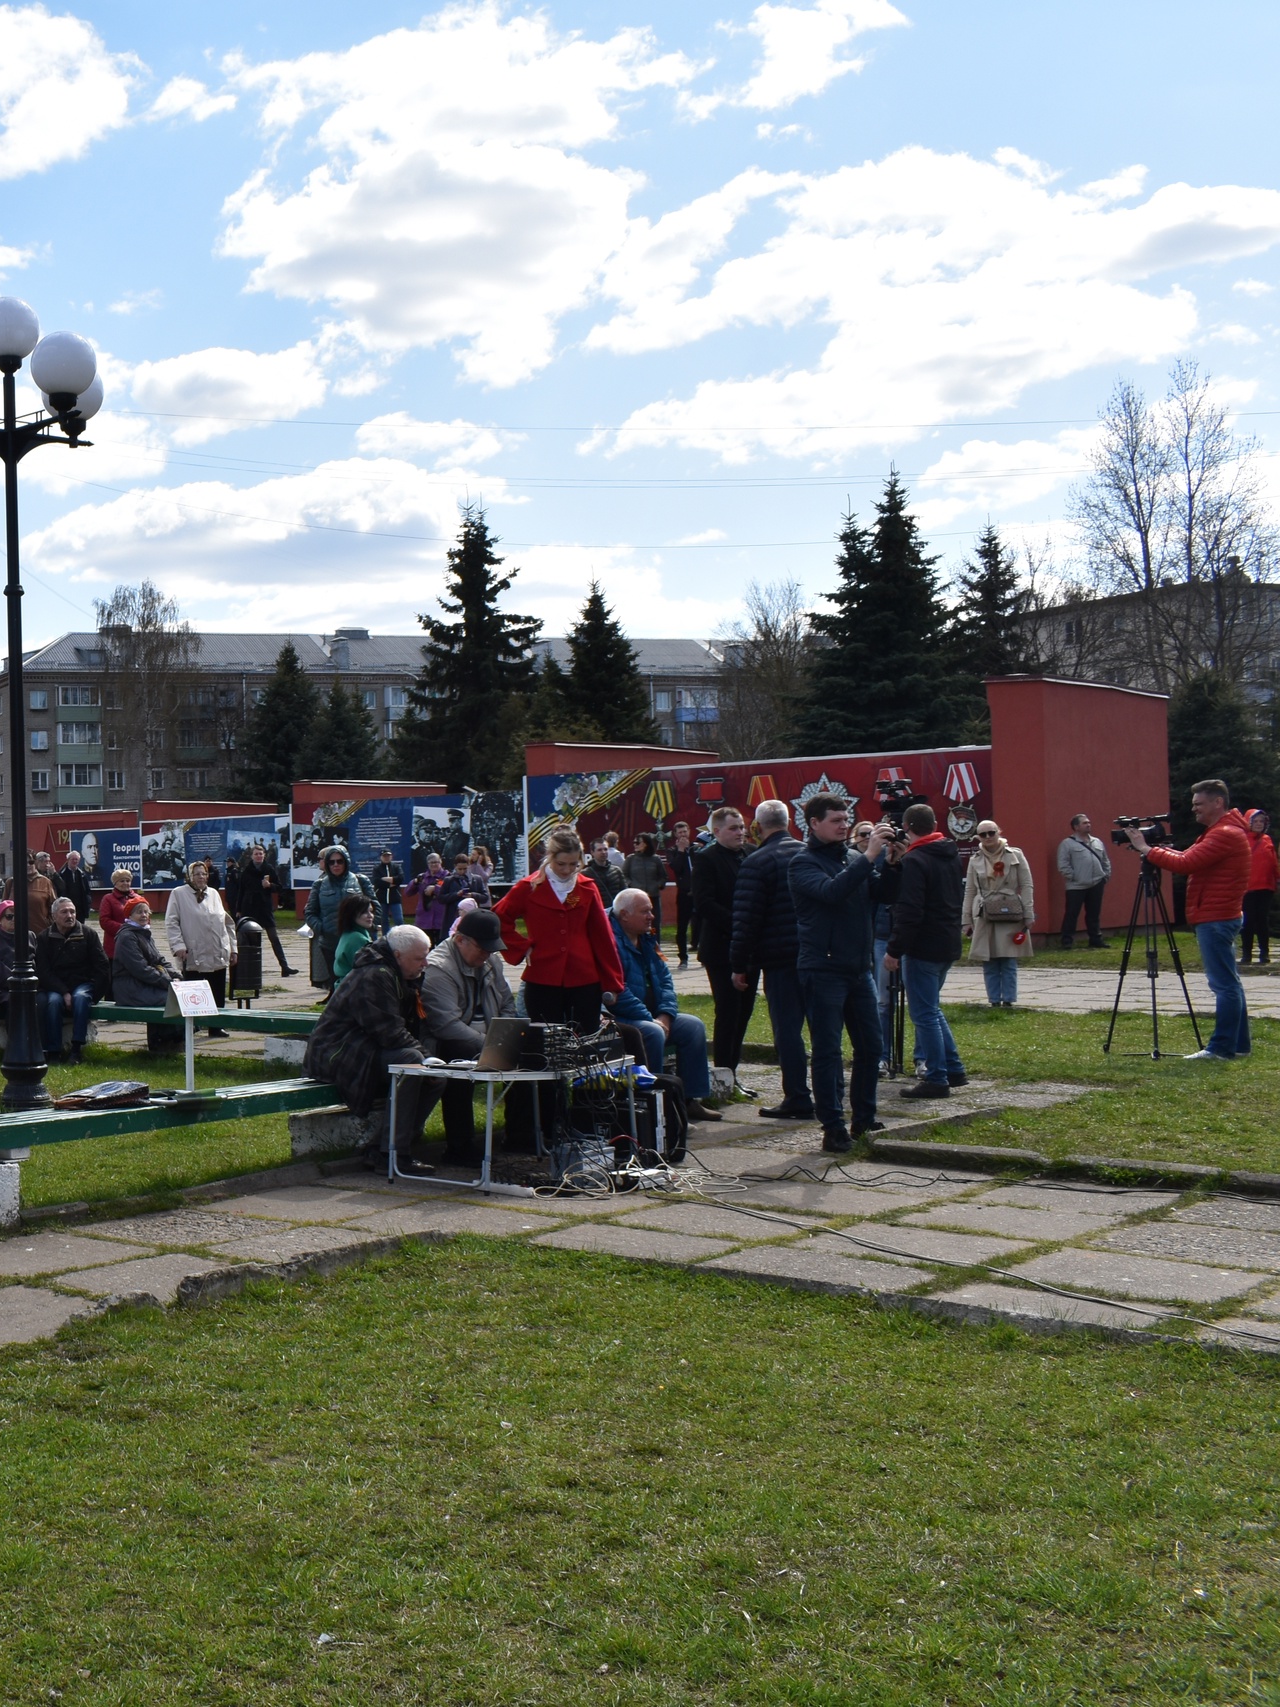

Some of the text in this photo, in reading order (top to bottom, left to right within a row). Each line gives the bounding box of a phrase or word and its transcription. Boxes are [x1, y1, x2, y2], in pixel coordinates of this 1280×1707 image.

[57, 829, 70, 845] 19
[112, 843, 140, 854] Георги
[113, 861, 140, 871] ЖУКО
